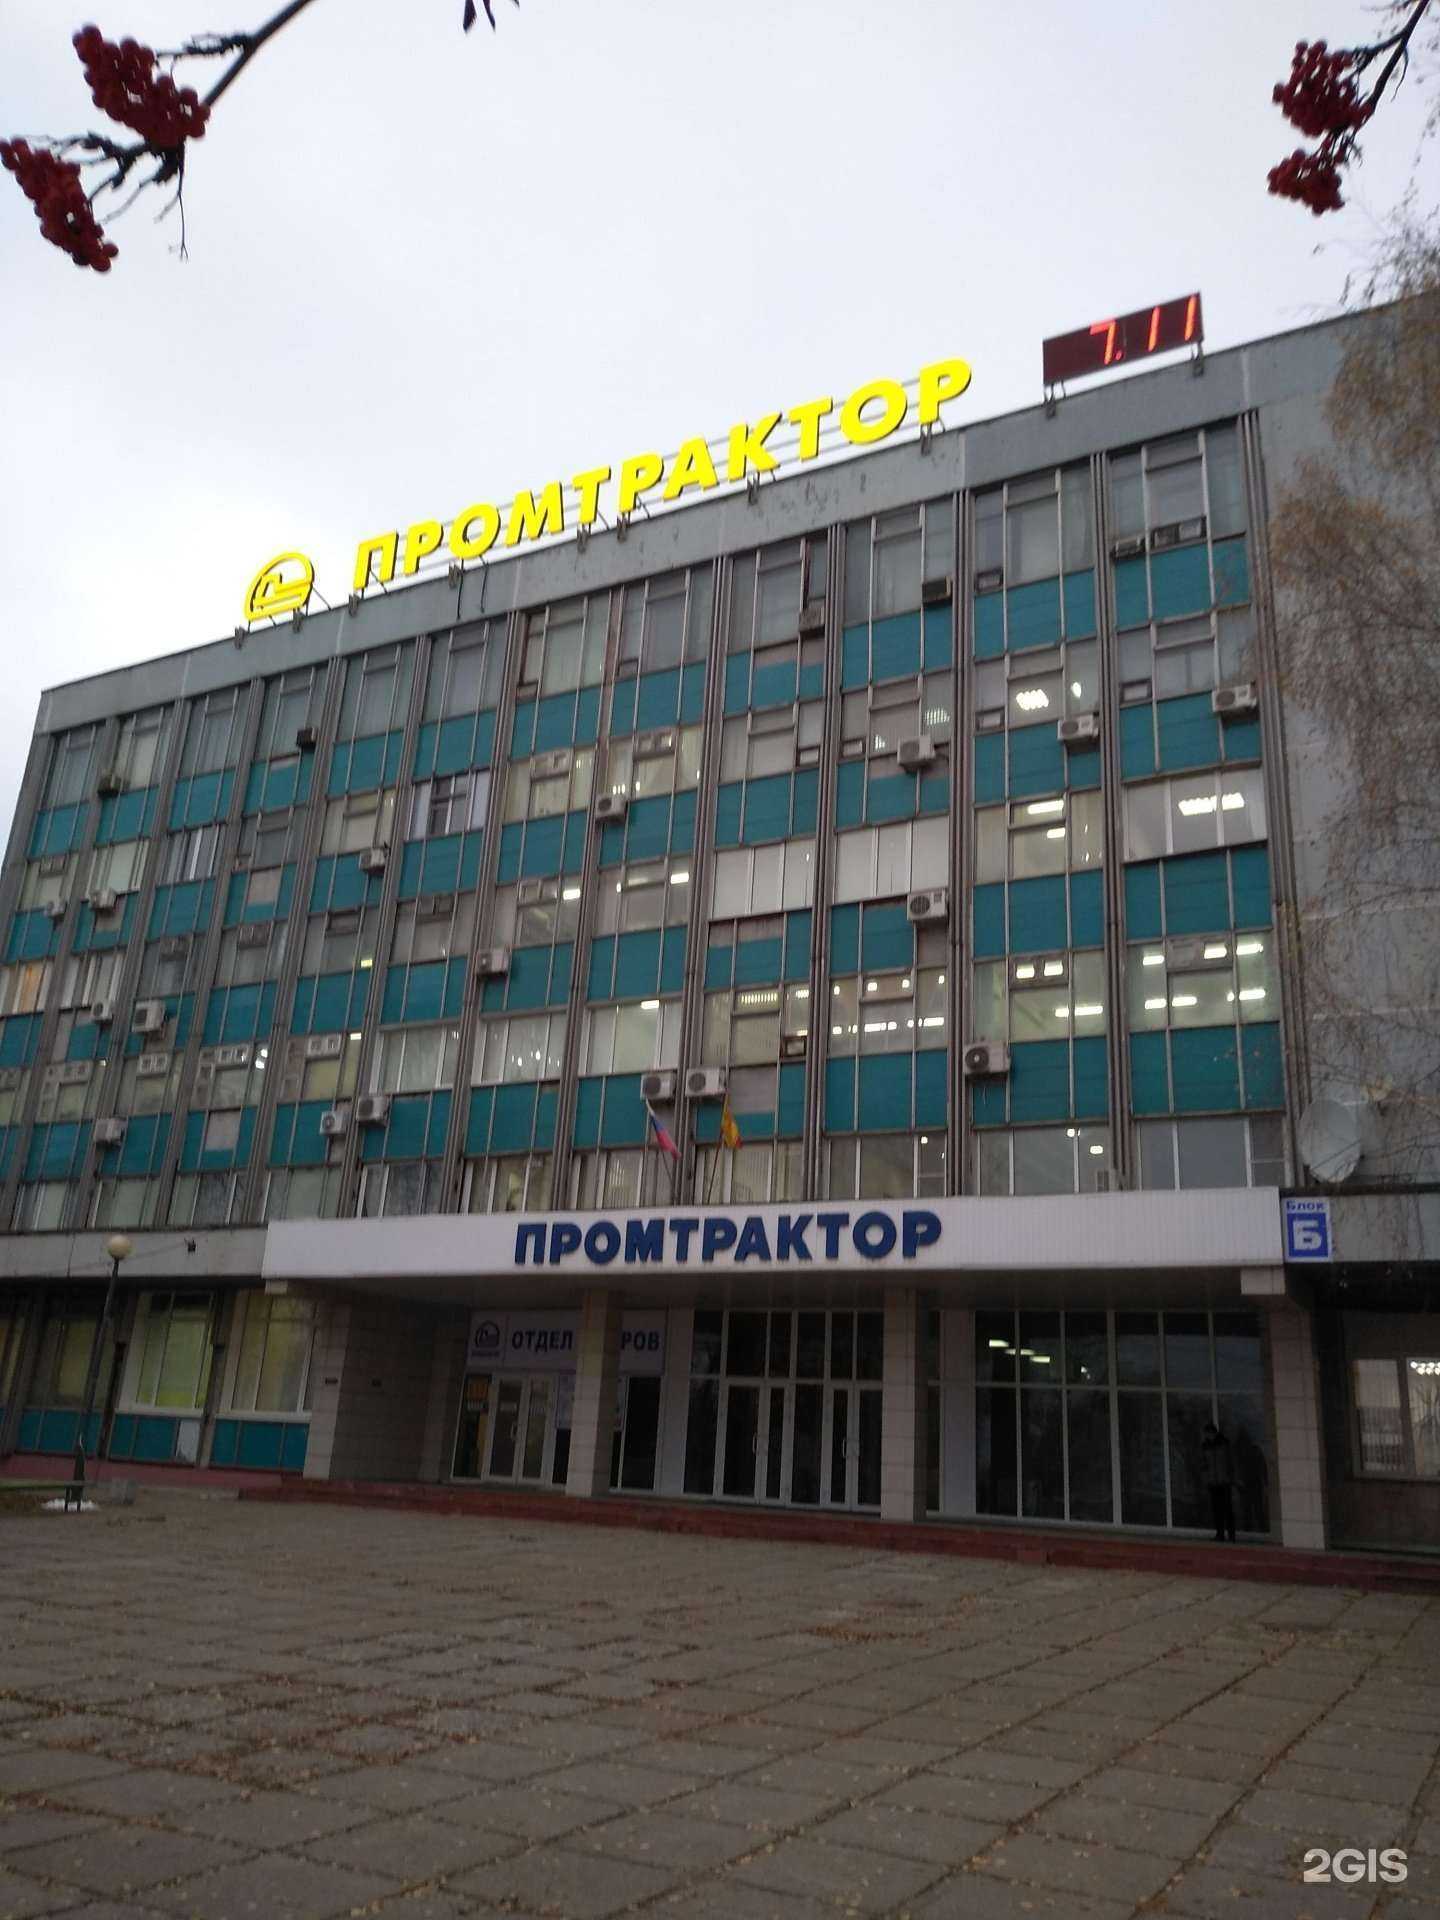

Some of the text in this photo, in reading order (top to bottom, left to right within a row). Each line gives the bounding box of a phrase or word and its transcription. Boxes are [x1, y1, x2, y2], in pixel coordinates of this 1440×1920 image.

[1089, 295, 1197, 366] 7.11
[352, 358, 973, 592] ПРОМТРАКТОР
[1286, 1200, 1325, 1210] Блок
[514, 1211, 942, 1265] ПРОМТРАКТОР
[1292, 1220, 1323, 1251] Б
[511, 1329, 661, 1352] ОТДЕЛ РОВ
